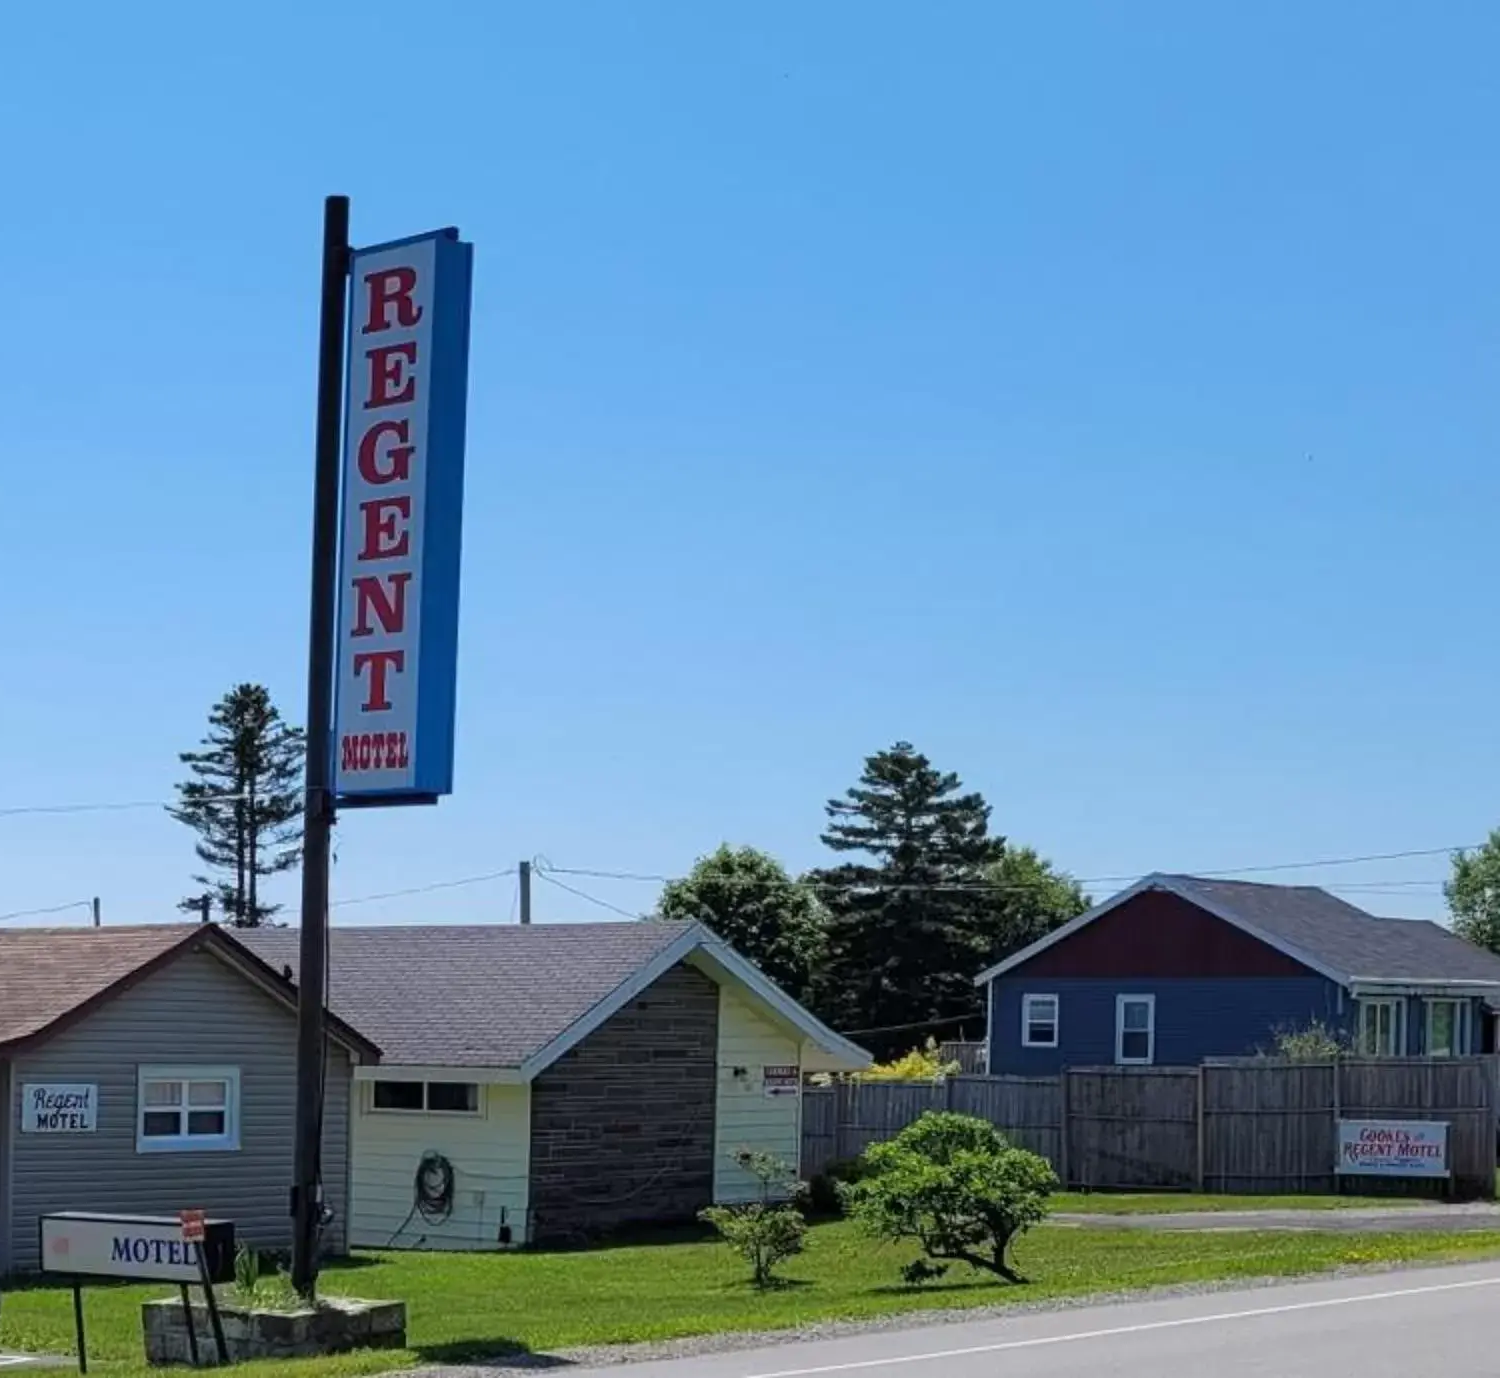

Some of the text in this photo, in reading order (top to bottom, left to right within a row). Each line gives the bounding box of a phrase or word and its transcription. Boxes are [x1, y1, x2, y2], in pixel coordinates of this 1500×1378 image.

[350, 265, 422, 713] REGENT
[341, 731, 409, 770] MOTEL
[33, 1087, 90, 1114] Regent
[36, 1113, 88, 1129] MOTEL
[1344, 1142, 1442, 1161] REGENT MOTEL
[111, 1237, 198, 1265] MOTEL
